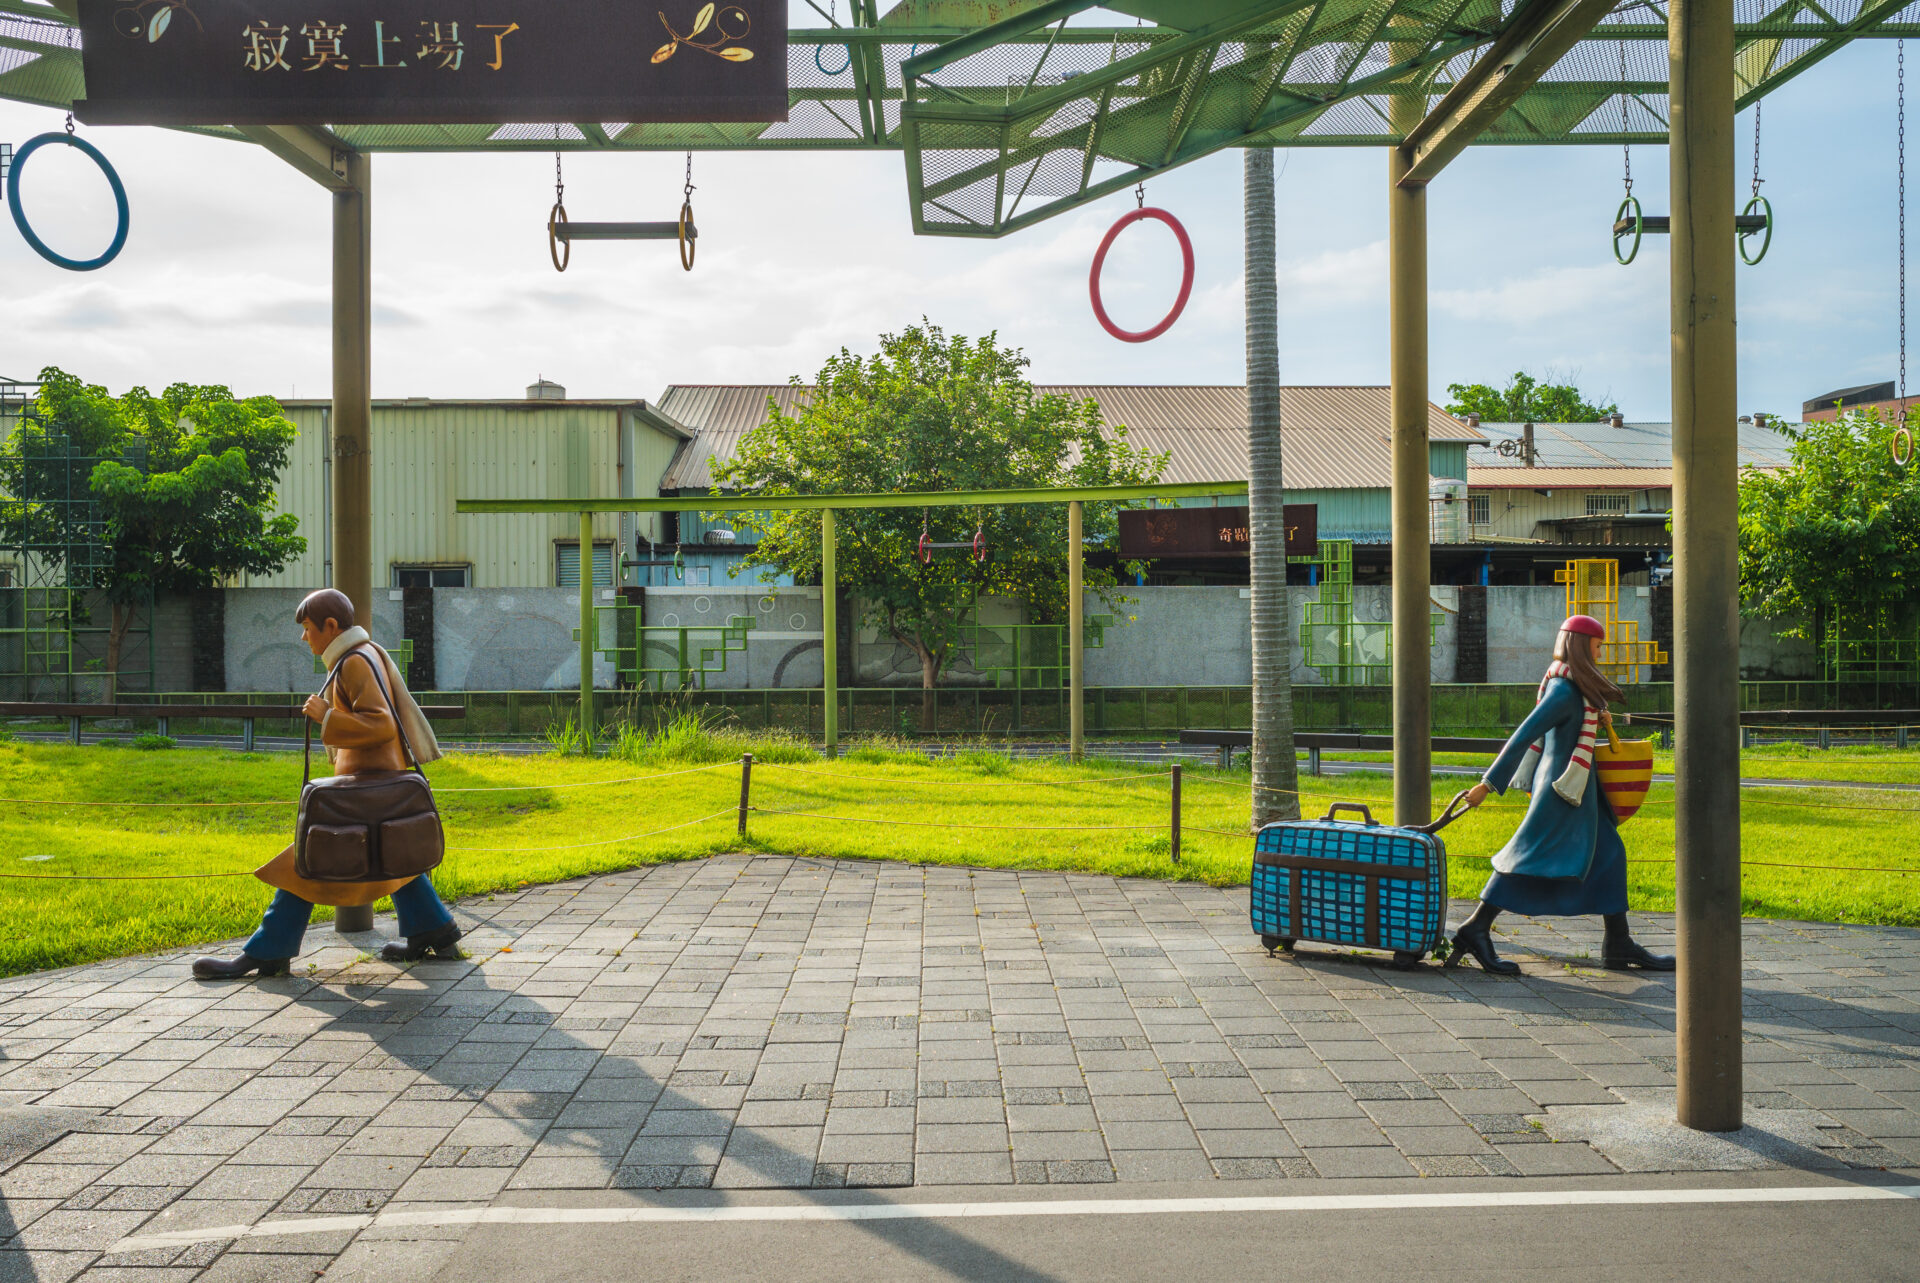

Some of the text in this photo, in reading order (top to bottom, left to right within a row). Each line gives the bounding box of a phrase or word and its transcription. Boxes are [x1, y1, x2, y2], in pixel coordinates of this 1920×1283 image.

[242, 20, 520, 71] 寂寞上場了
